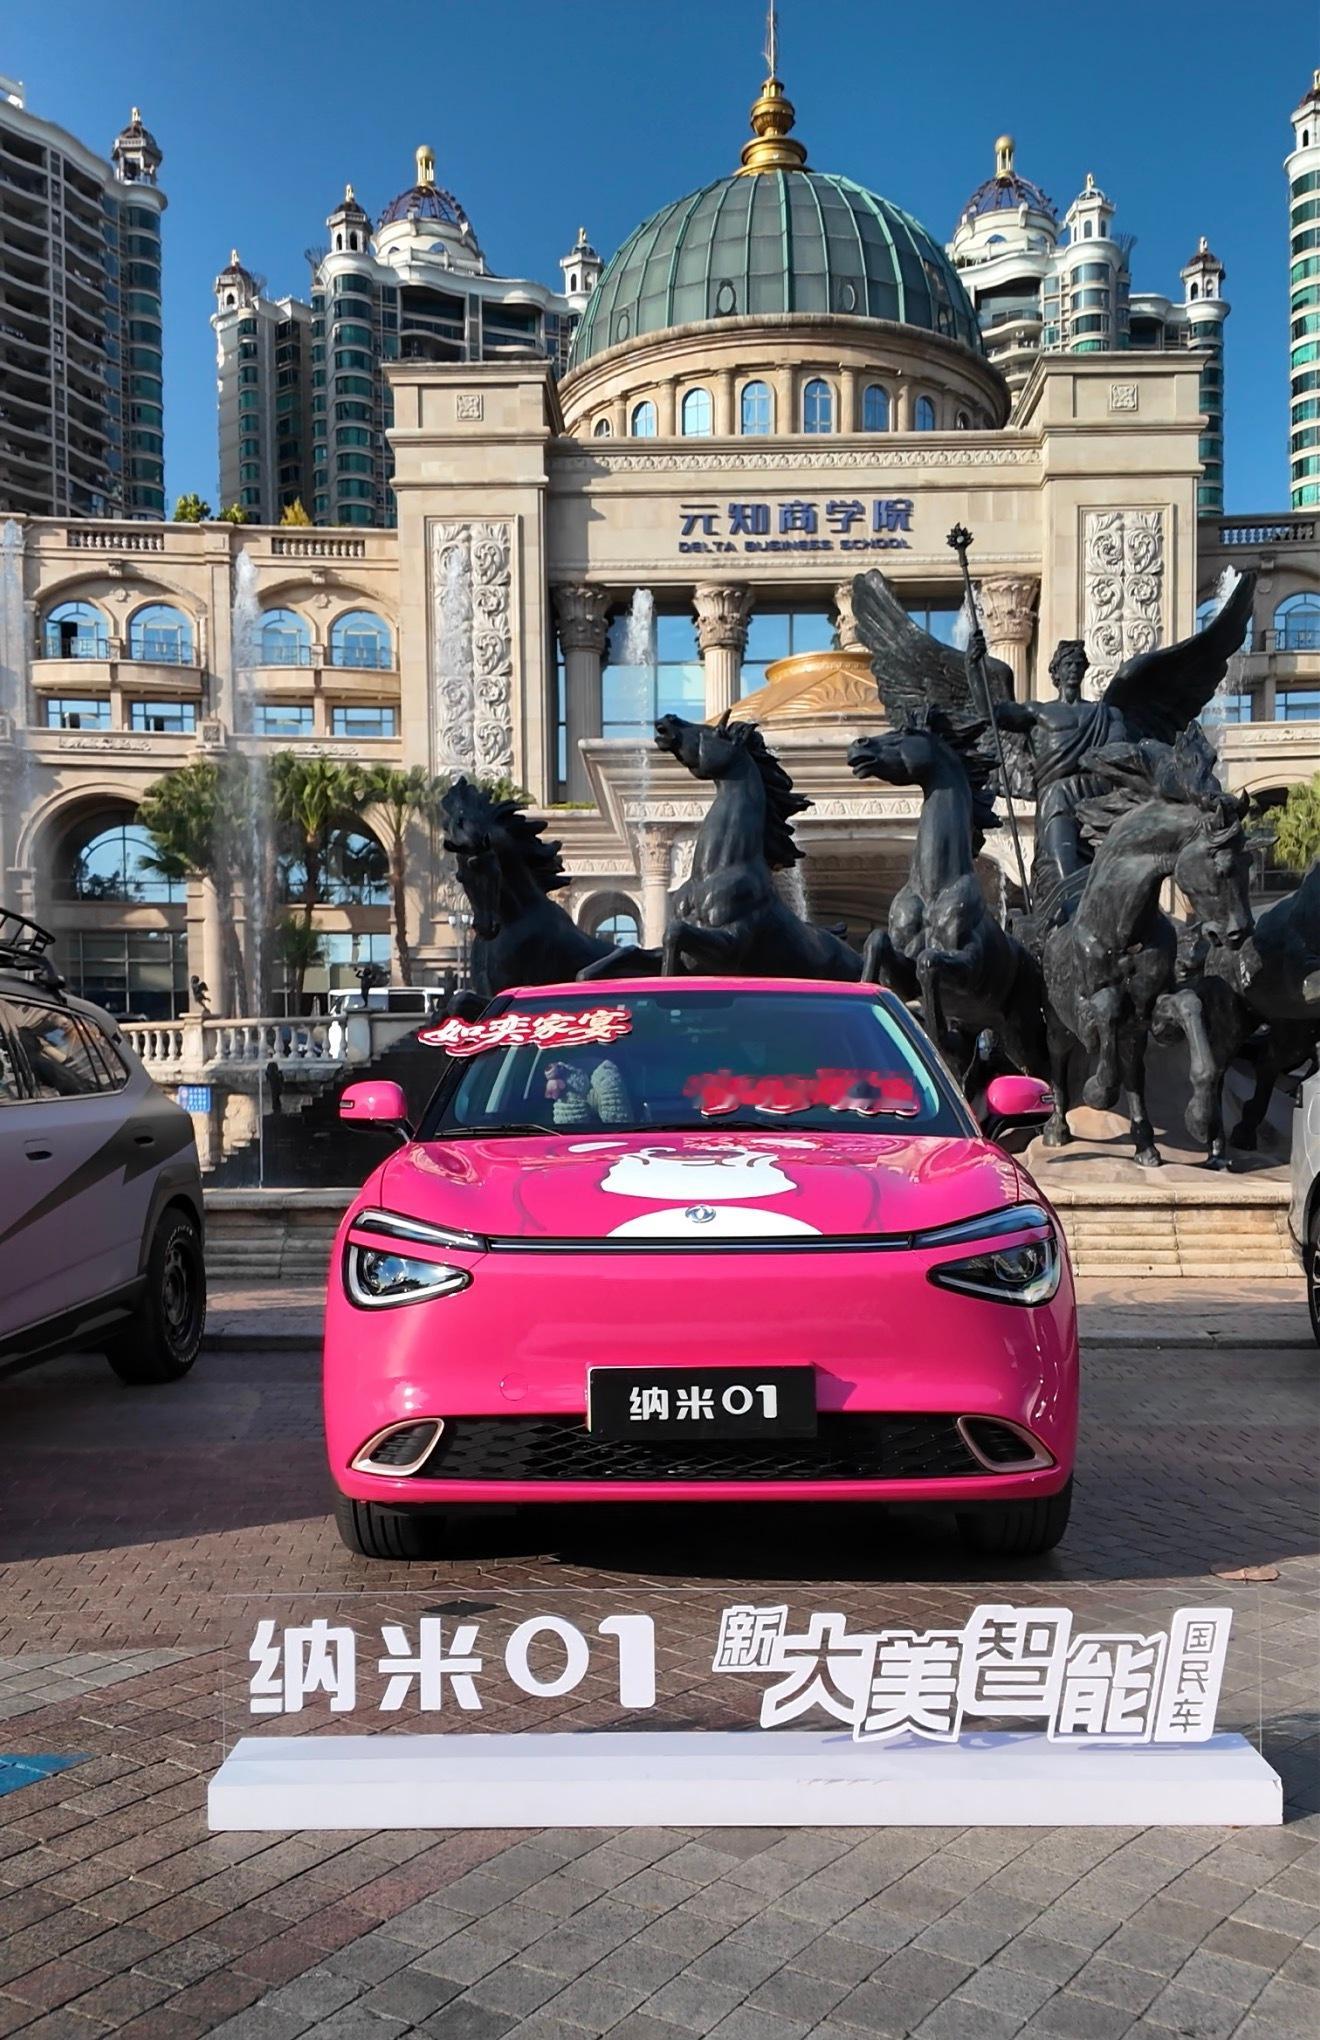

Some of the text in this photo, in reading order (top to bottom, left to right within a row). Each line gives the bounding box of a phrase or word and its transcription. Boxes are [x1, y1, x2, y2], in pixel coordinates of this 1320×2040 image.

[679, 498, 915, 536] 元知商学院
[678, 537, 913, 554] DELTA BUSINESS SCHOOL
[629, 1384, 778, 1422] 纳米01
[248, 1614, 656, 1714] 纳米01
[1169, 1619, 1215, 1734] 国民车
